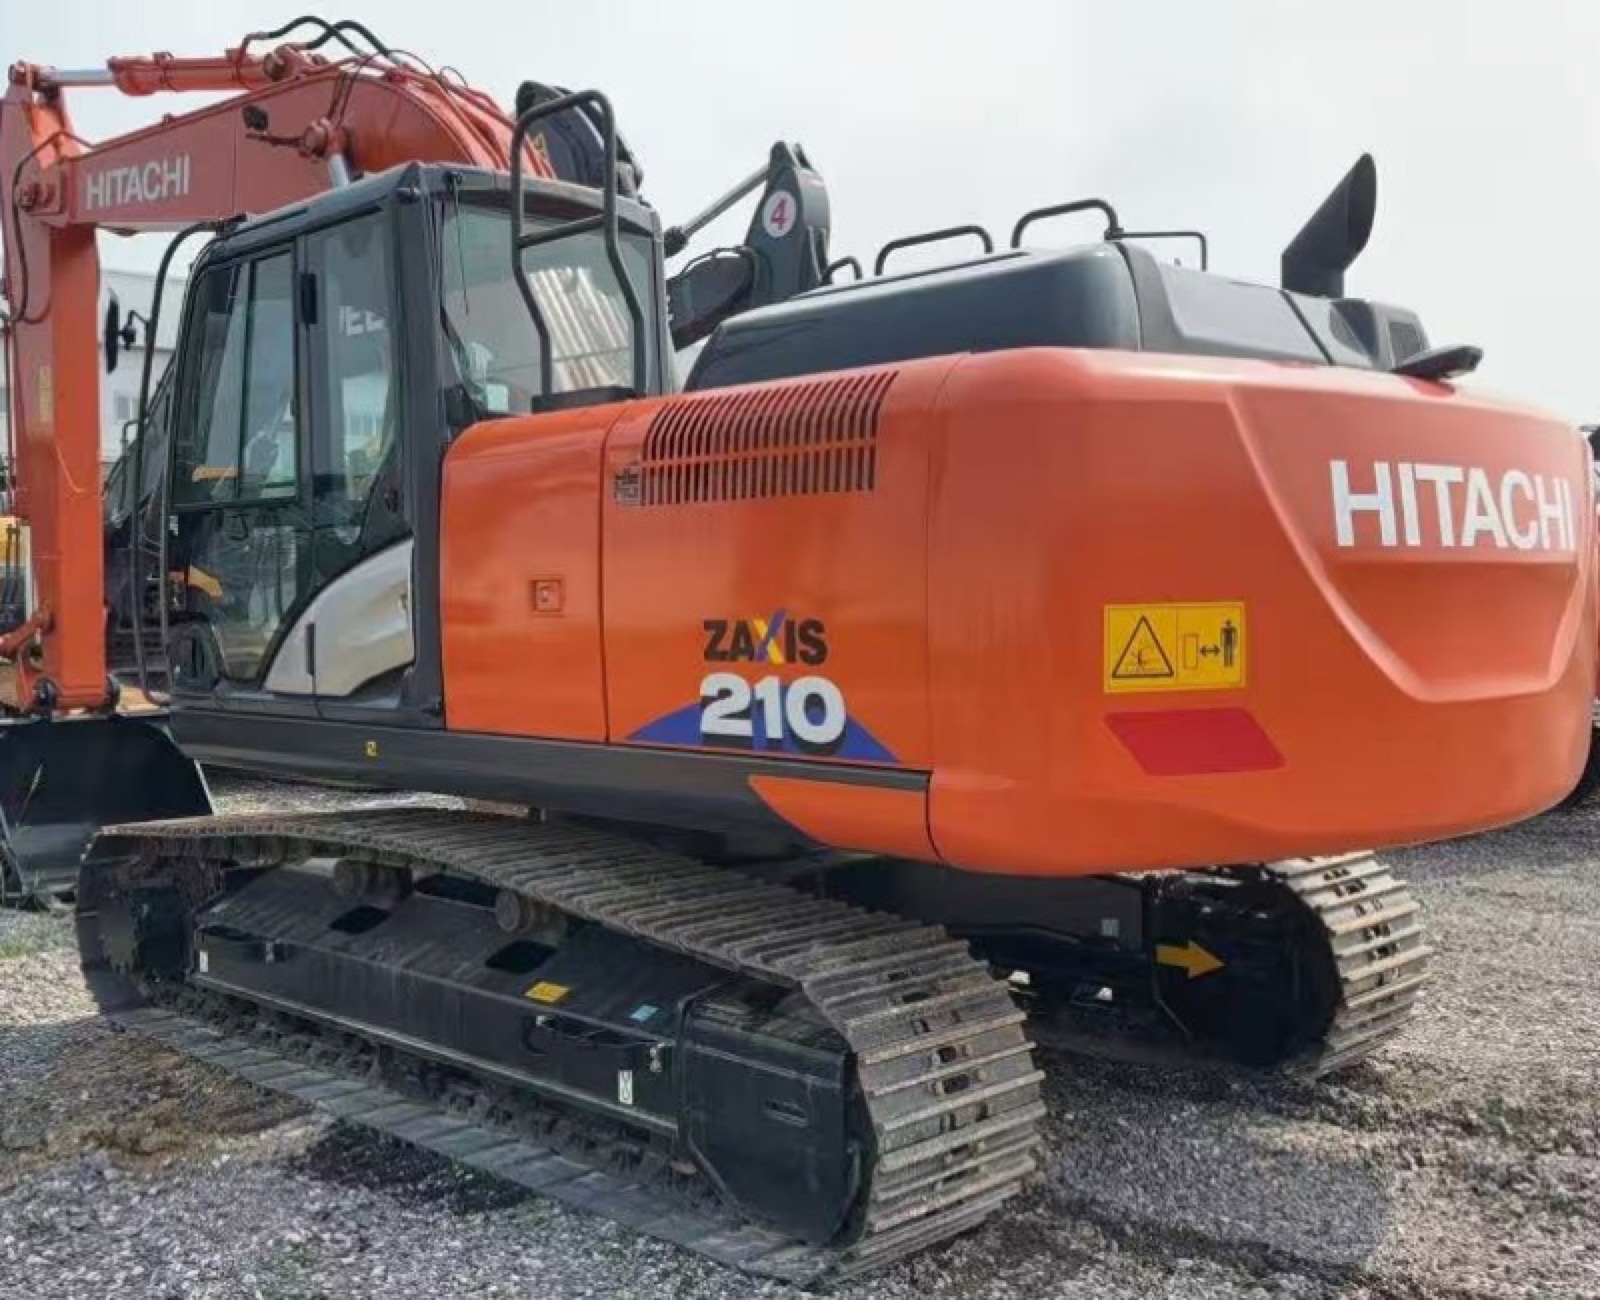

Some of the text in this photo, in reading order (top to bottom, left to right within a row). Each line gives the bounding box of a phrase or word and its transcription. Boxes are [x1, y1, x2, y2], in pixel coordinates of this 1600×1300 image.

[85, 153, 190, 210] HITACHI
[770, 198, 788, 230] 4
[1329, 459, 1575, 551] HITACHI
[703, 608, 827, 666] ZAXIS
[699, 672, 847, 749] 210
